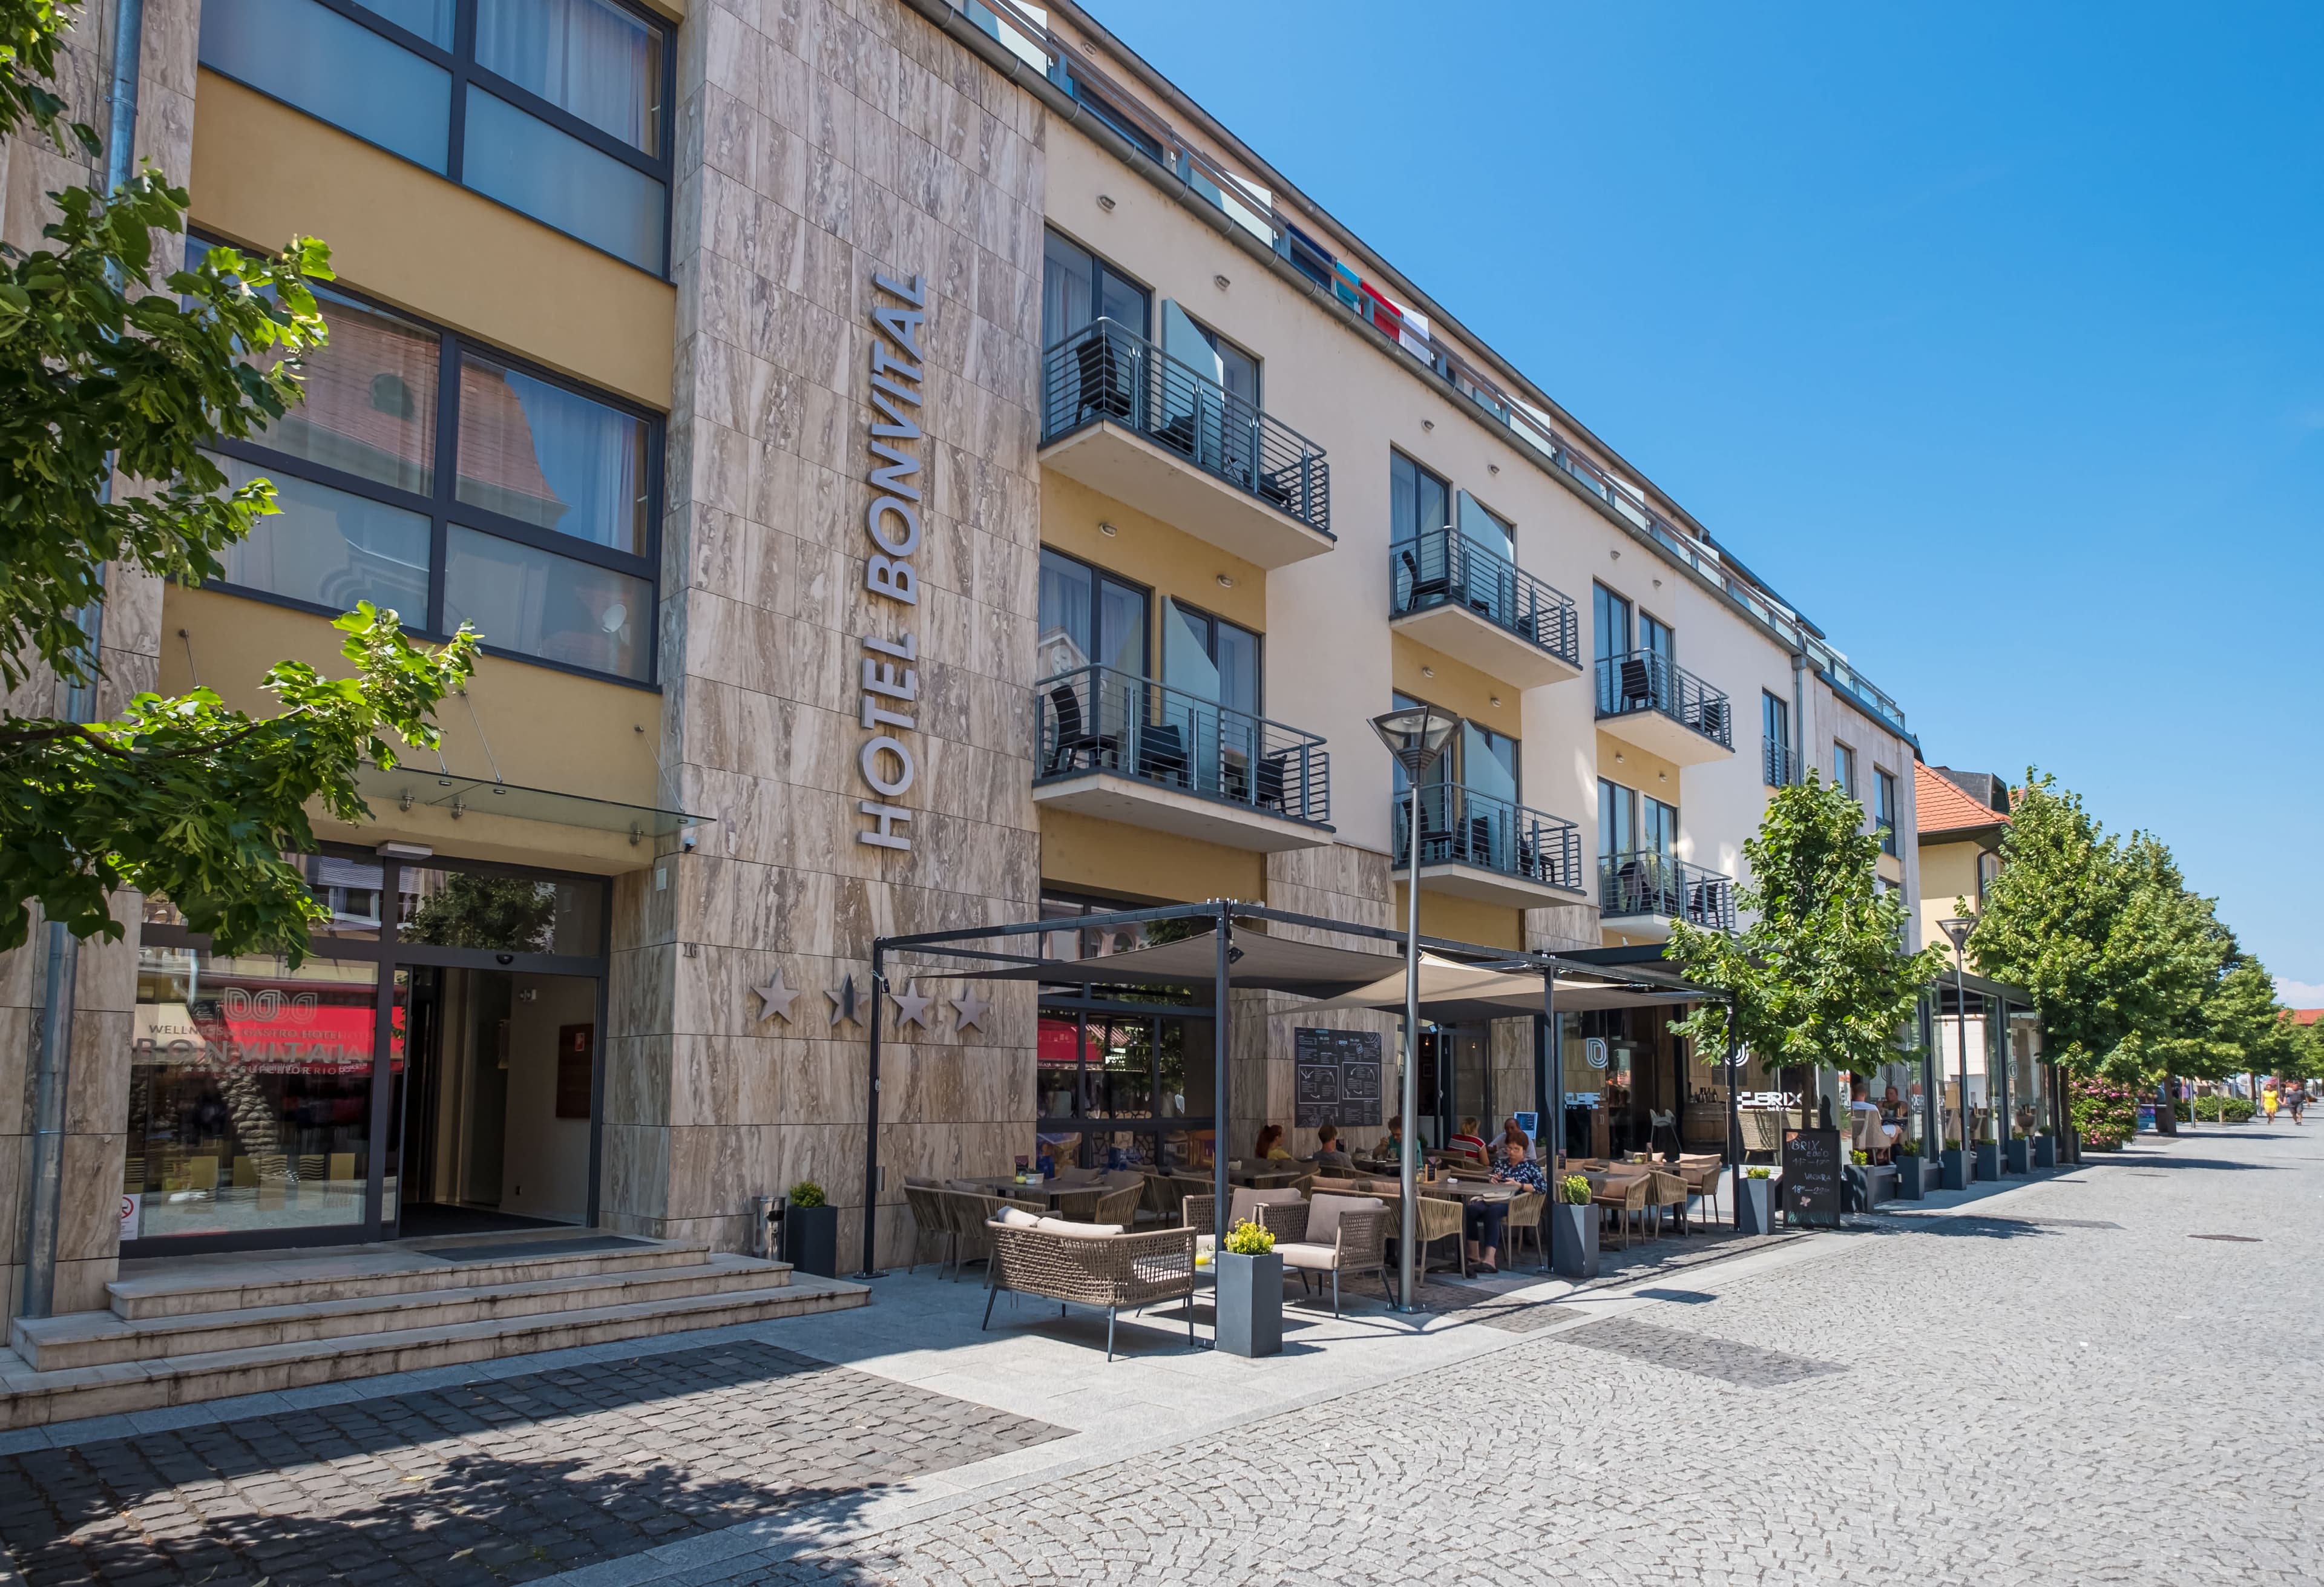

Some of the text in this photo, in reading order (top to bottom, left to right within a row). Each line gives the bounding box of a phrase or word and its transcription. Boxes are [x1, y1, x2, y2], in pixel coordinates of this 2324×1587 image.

[859, 271, 926, 850] HOTEL BONVITAL
[243, 1028, 297, 1039] GASTRO
[136, 1037, 352, 1064] BONVITAL
[1754, 1091, 1802, 1106] BRIX
